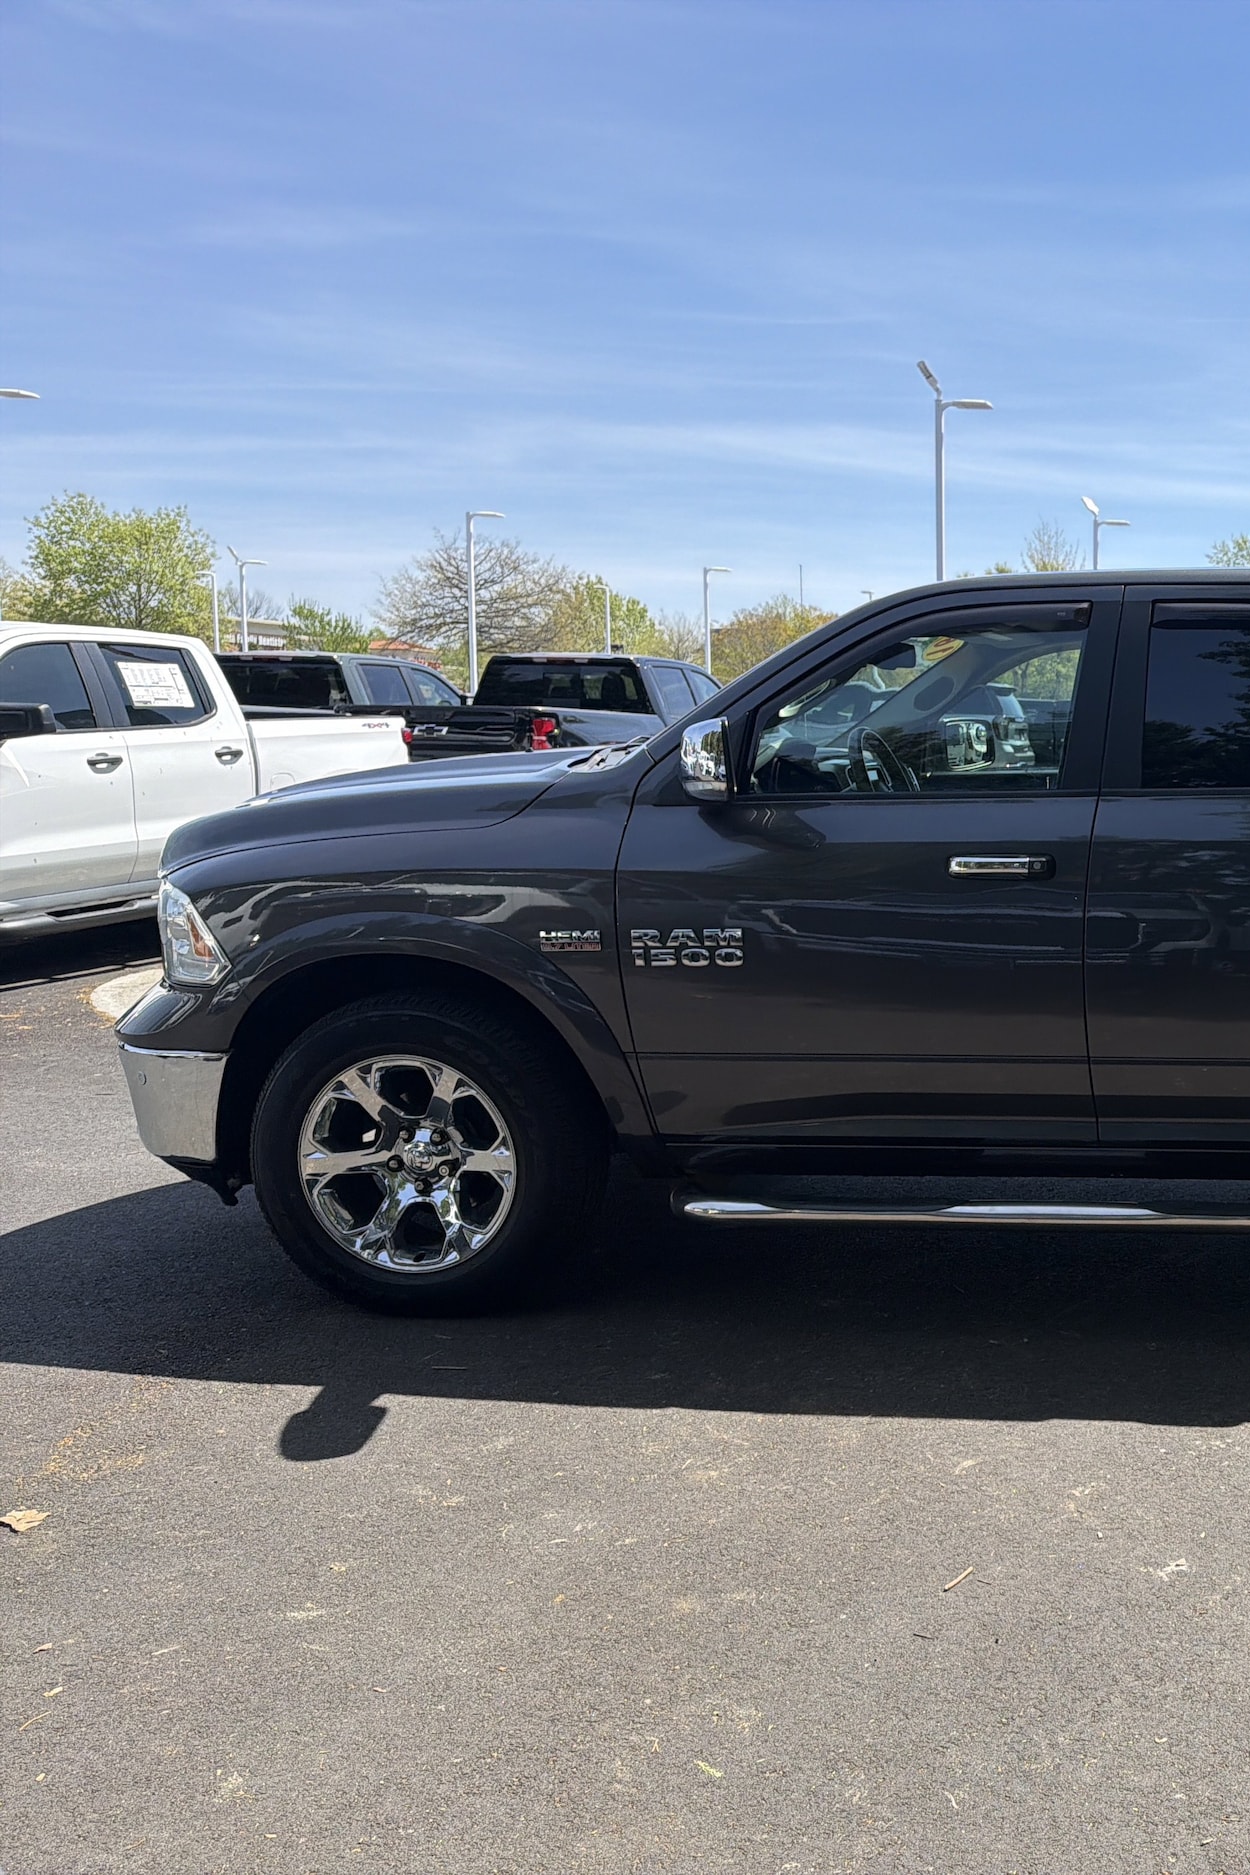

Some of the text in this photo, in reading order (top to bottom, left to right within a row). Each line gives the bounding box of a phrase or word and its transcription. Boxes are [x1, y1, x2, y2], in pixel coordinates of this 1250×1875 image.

[539, 929, 601, 942] HEMI
[630, 928, 744, 947] RAM
[631, 948, 744, 967] 1500
